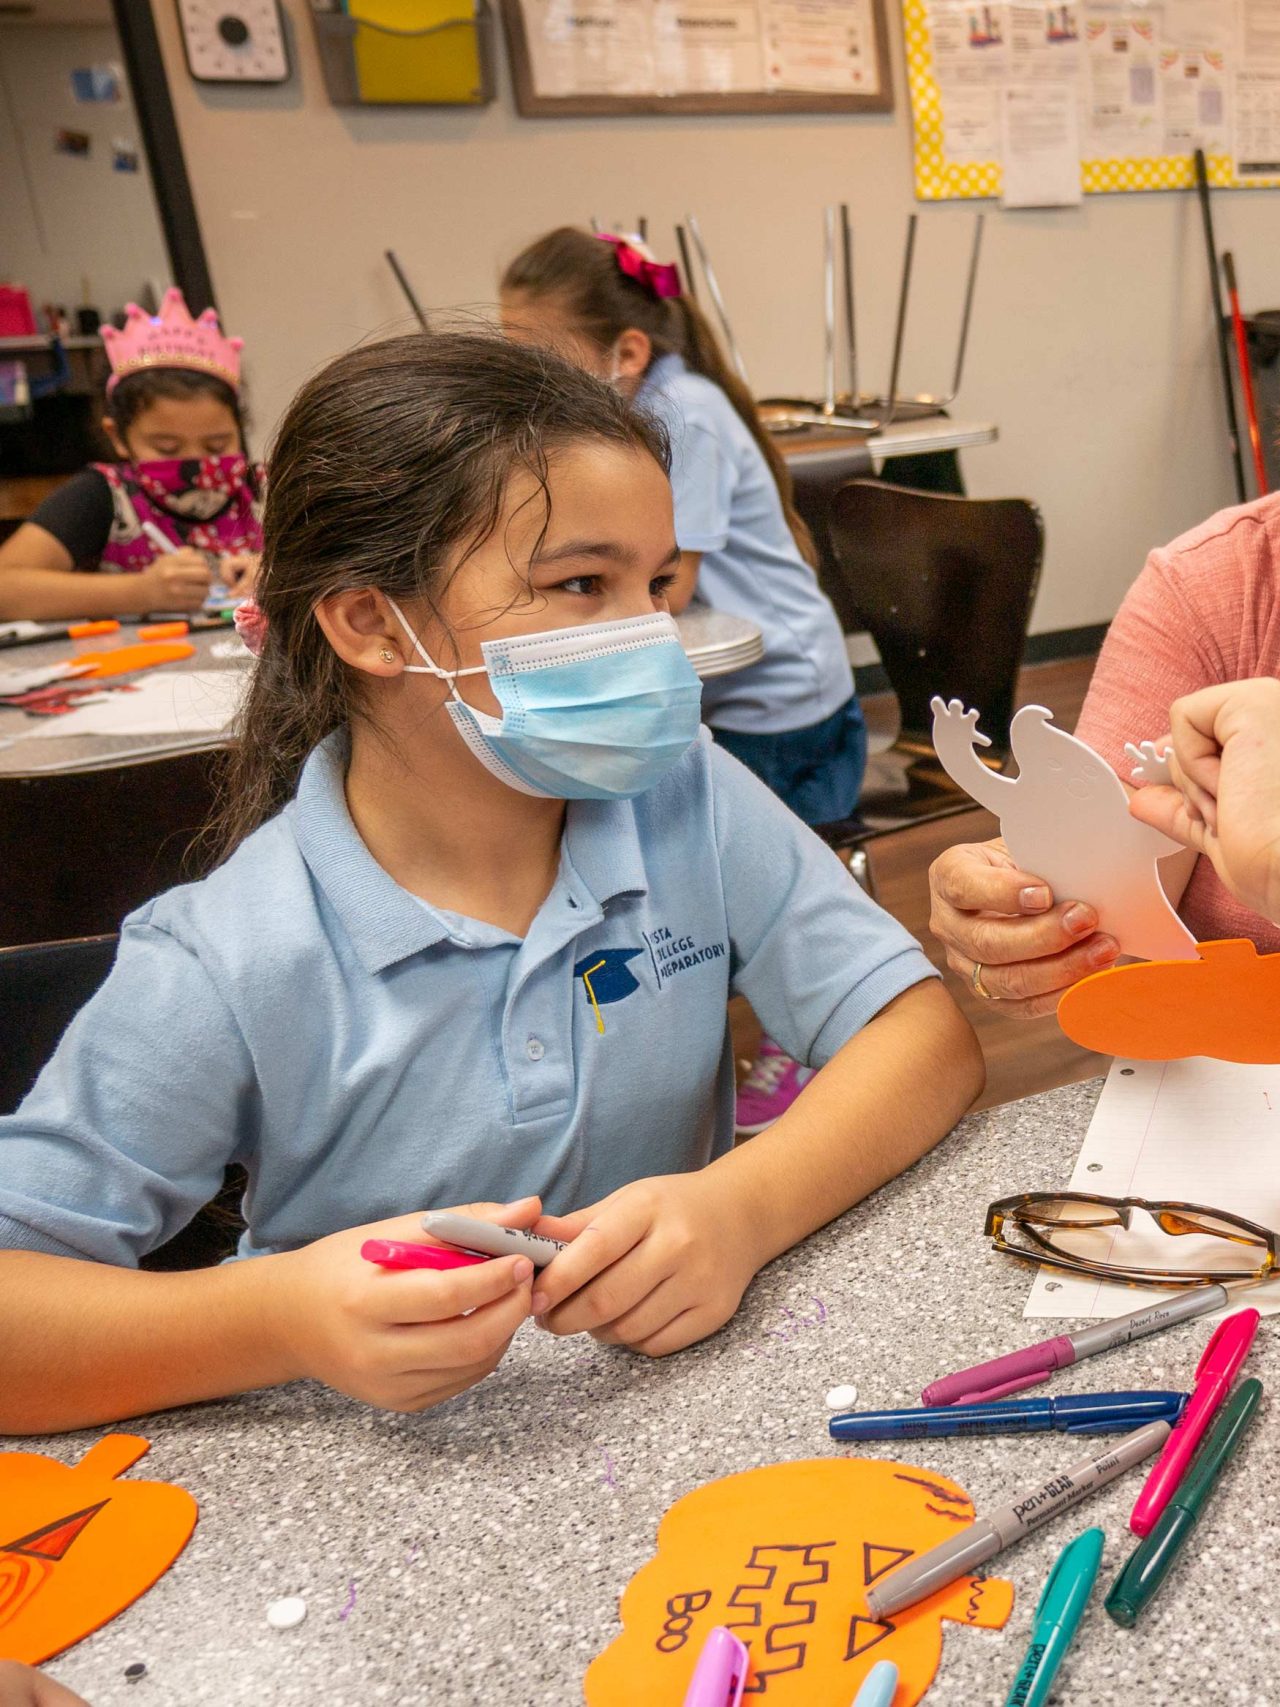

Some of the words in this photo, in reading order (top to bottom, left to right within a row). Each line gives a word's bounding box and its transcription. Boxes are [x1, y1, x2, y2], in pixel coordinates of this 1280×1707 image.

[650, 926, 673, 944] STA
[1095, 1456, 1120, 1475] Point
[655, 1589, 712, 1653] Boo
